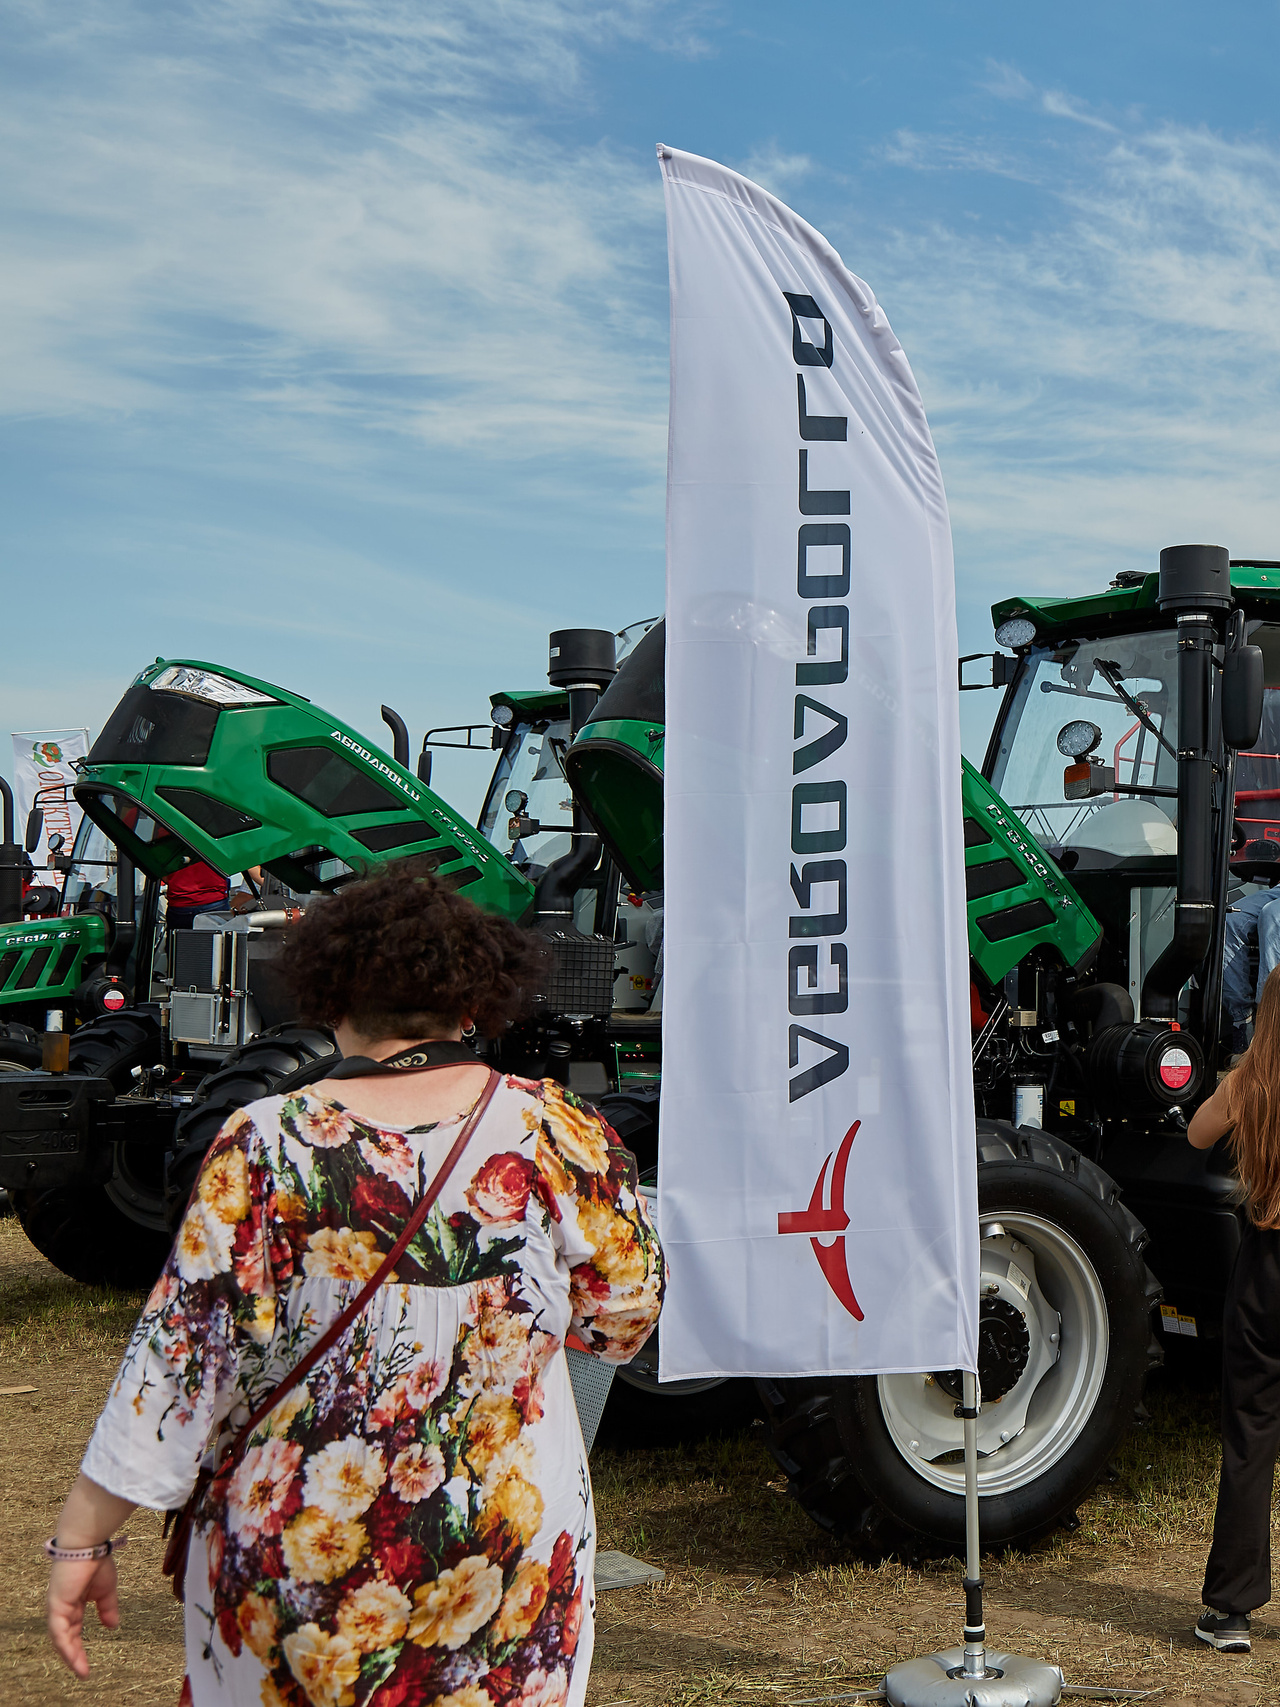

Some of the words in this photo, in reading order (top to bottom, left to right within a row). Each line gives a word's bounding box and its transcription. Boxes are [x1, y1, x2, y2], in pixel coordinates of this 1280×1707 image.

[330, 730, 421, 803] AGROAPOLLO
[984, 802, 1072, 910] CFG1404-X
[41, 1131, 77, 1151] 40kg
